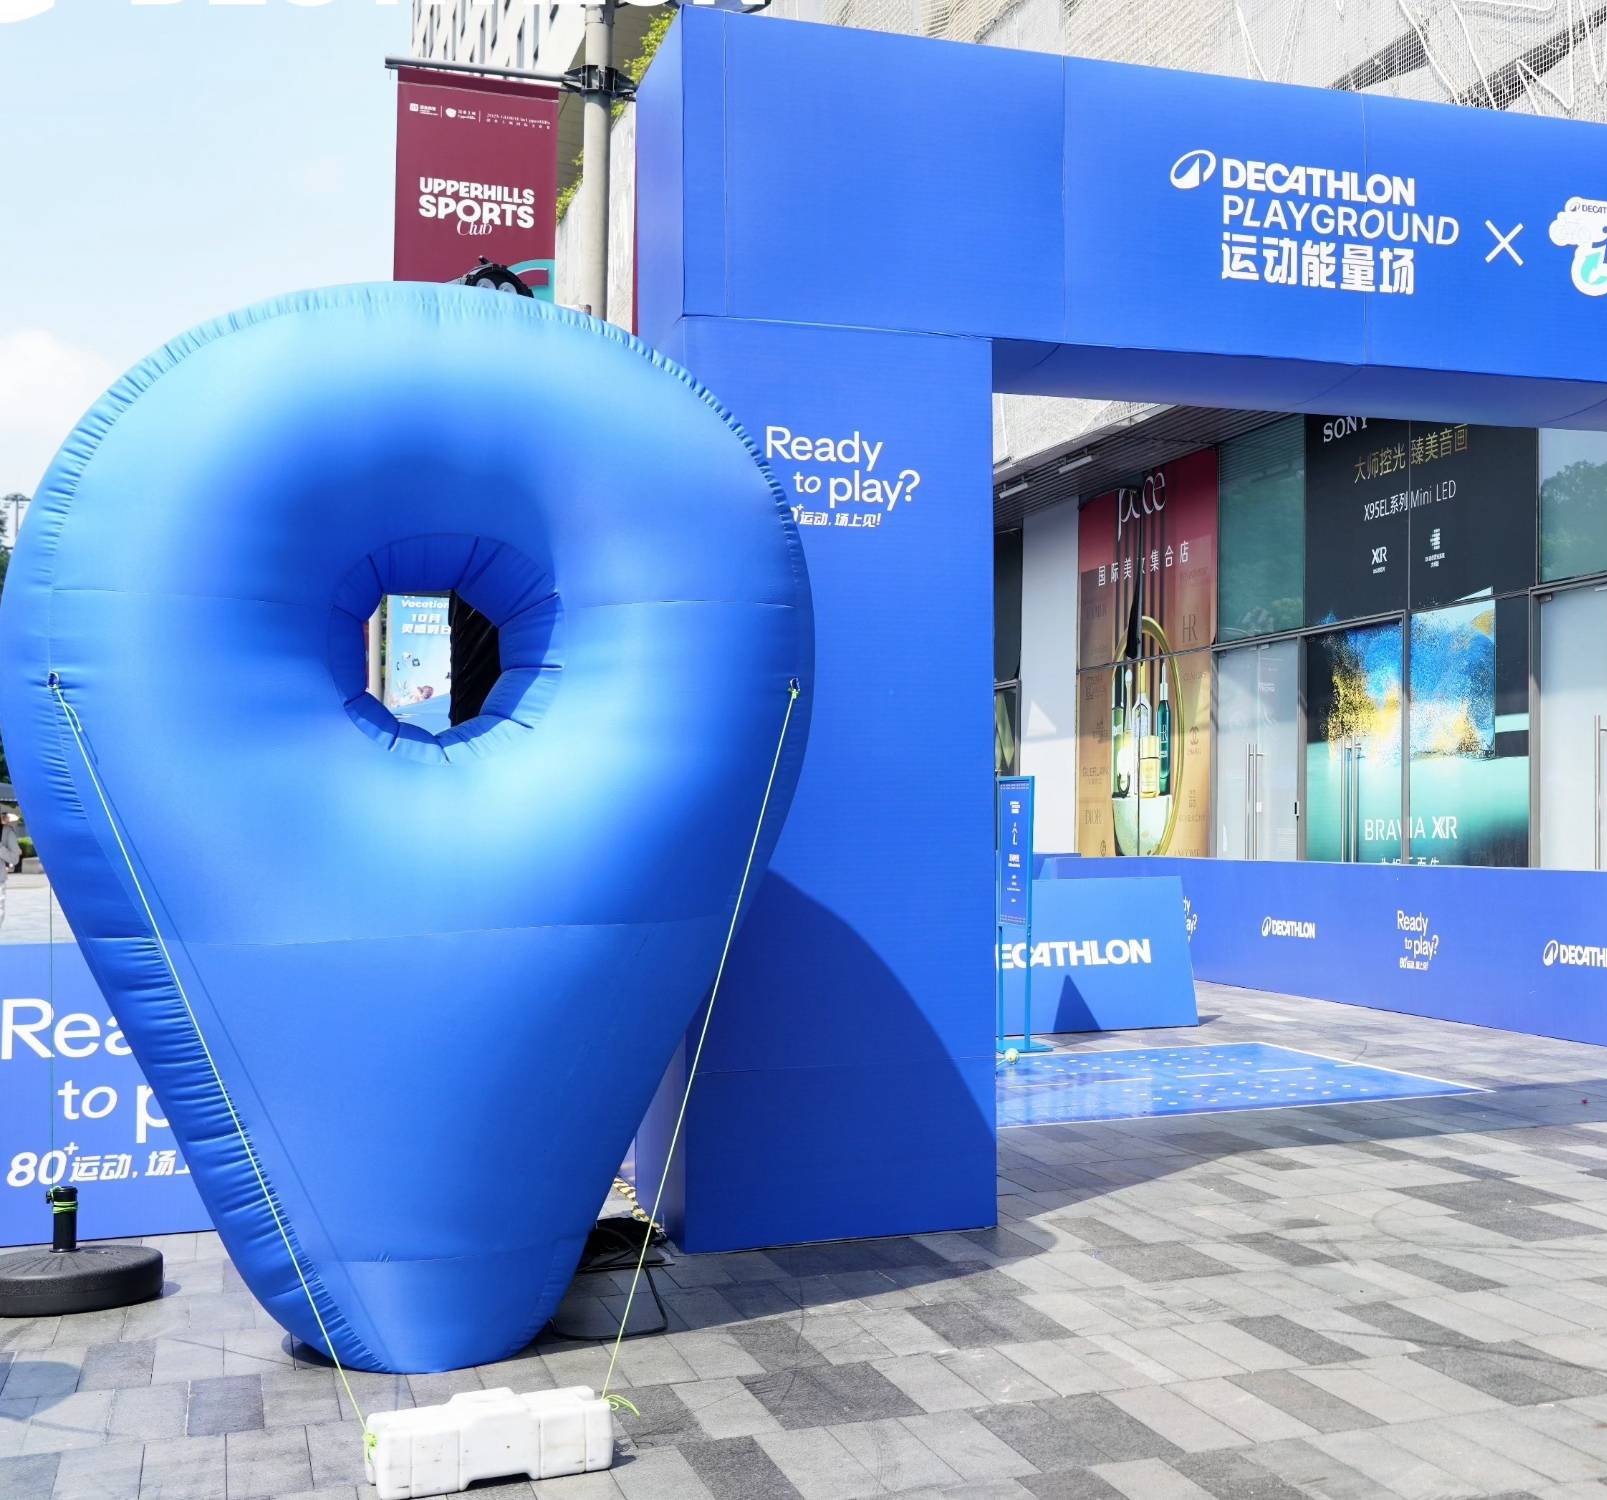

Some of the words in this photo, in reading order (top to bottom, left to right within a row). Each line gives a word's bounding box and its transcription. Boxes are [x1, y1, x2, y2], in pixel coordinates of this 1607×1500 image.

[419, 176, 535, 205] UPPERHILLS
[1222, 157, 1415, 206] DECATHLON
[418, 194, 535, 229] SPORTS
[456, 218, 493, 236] Club
[1222, 194, 1460, 245] PLAYGROUND
[1221, 231, 1415, 295] 运动能量场
[766, 425, 883, 472] Ready
[1323, 416, 1368, 443] SONY
[1353, 442, 1406, 484] 大师控光
[1410, 423, 1469, 465] 臻美音画
[793, 471, 822, 493] to
[829, 469, 921, 511] play?
[1363, 490, 1408, 521] X95EL系列
[1410, 485, 1432, 509] Mini
[1436, 479, 1457, 502] LED
[1271, 919, 1316, 939] DECATHLON
[1396, 910, 1429, 937] Ready
[1404, 936, 1413, 950] to
[1413, 934, 1439, 961] play?
[57, 1079, 119, 1120] to
